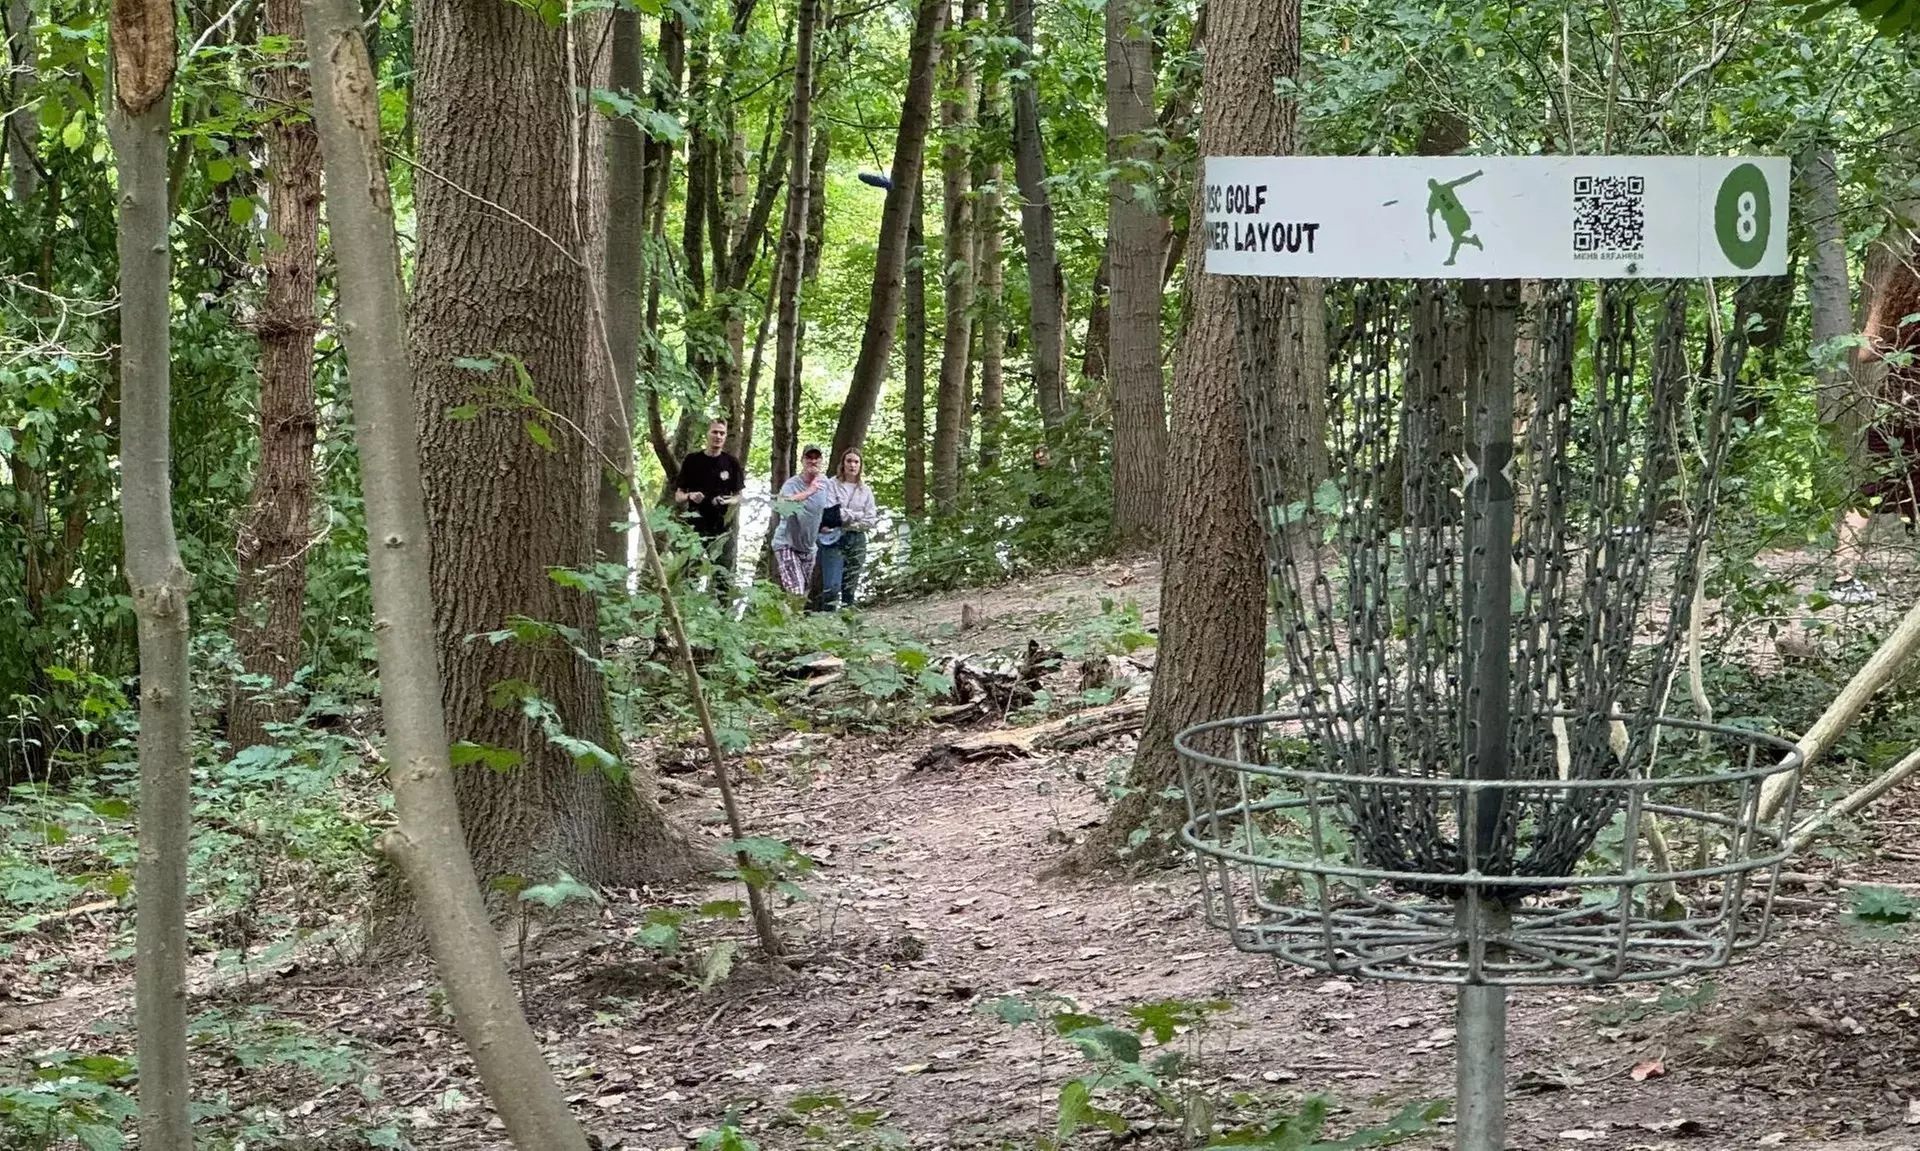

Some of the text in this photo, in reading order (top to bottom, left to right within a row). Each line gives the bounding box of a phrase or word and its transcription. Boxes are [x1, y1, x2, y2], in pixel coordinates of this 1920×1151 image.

[1205, 184, 1267, 214] ISC GOLF
[1737, 191, 1756, 242] 8
[1235, 221, 1320, 253] LAYOUT
[1573, 252, 1644, 260] MEHR ERFAHREN
